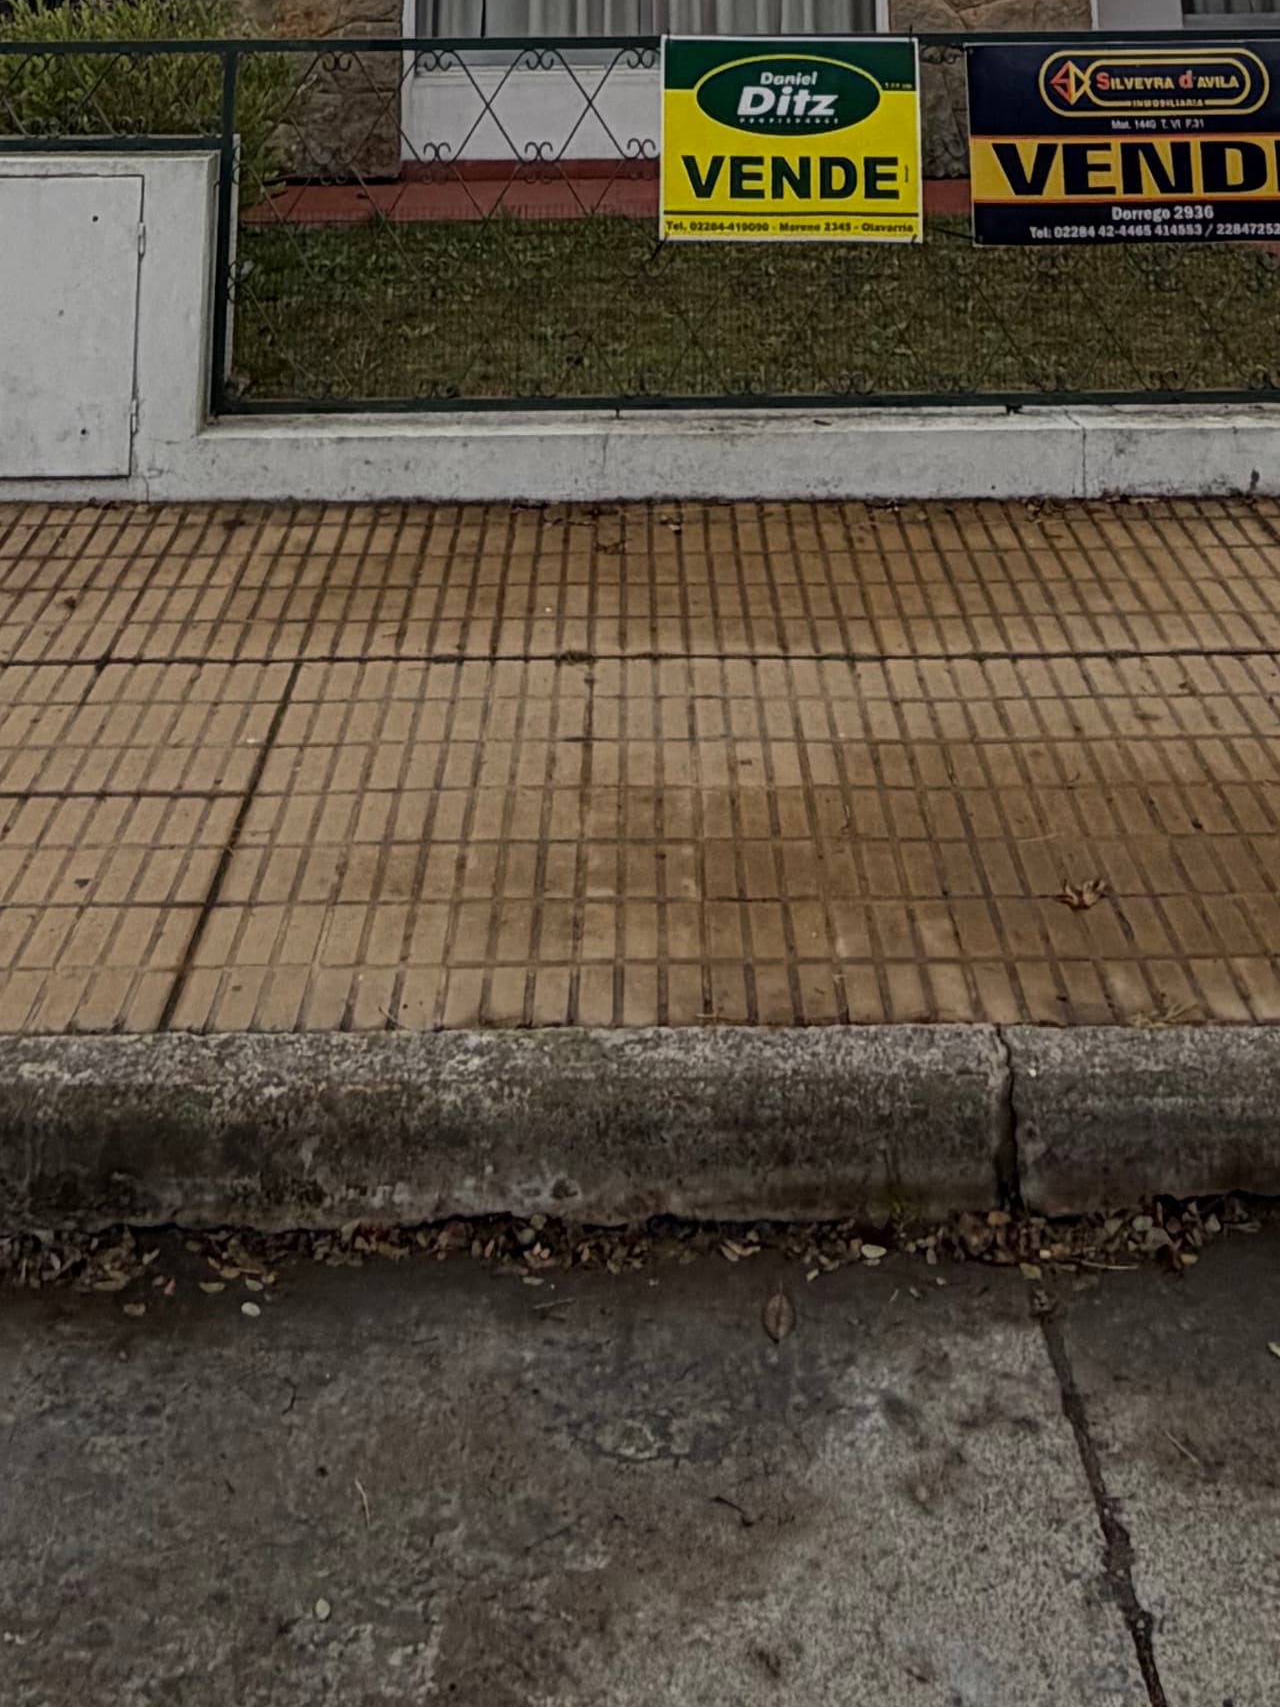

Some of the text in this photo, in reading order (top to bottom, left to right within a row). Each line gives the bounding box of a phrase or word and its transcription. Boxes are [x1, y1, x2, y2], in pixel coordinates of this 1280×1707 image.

[760, 71, 818, 86] Daniel
[1096, 72, 1175, 91] SILVEYRA
[736, 86, 839, 116] Ditz
[1132, 99, 1204, 108] INMOBILIARIA
[681, 155, 900, 199] VENDE
[1111, 205, 1214, 223] Dorrego 2936
[666, 221, 687, 231] Tel.
[779, 222, 821, 232] Moreno
[824, 222, 851, 232] 2345
[1029, 226, 1052, 238] Tel:
[1054, 225, 1095, 238] 02284
[1098, 224, 1151, 237] 42-4465
[1154, 224, 1202, 236] 414553
